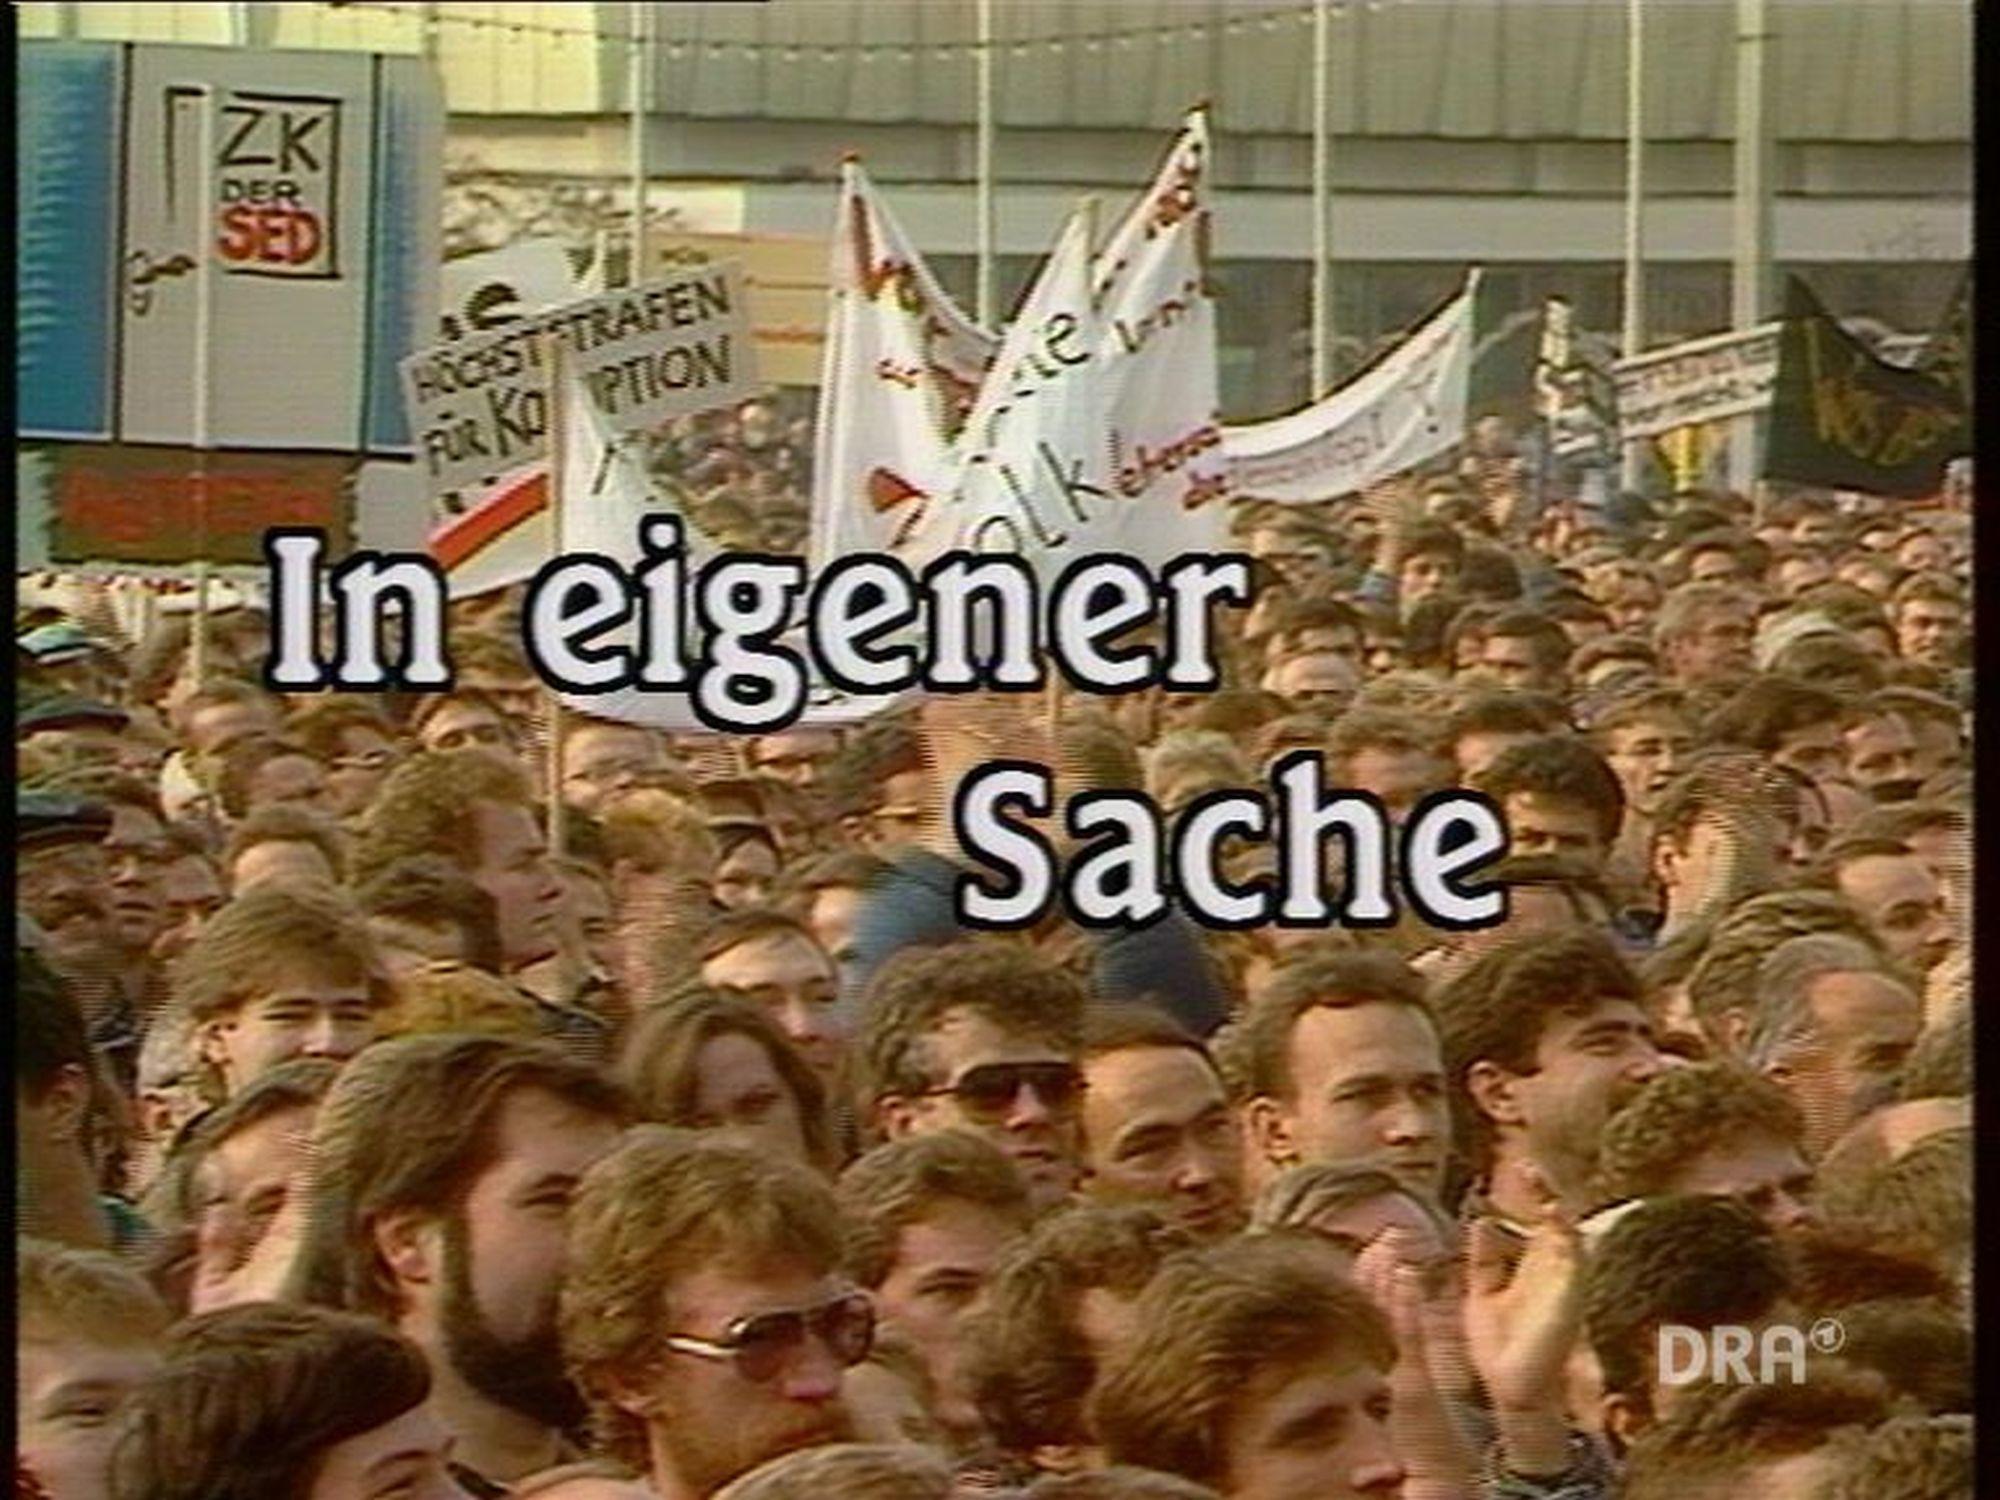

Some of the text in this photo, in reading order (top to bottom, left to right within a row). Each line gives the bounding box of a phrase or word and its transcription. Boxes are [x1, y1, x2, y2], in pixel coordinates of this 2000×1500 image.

[219, 105, 323, 173] ZK
[221, 178, 303, 204] DER
[217, 204, 322, 265] SED
